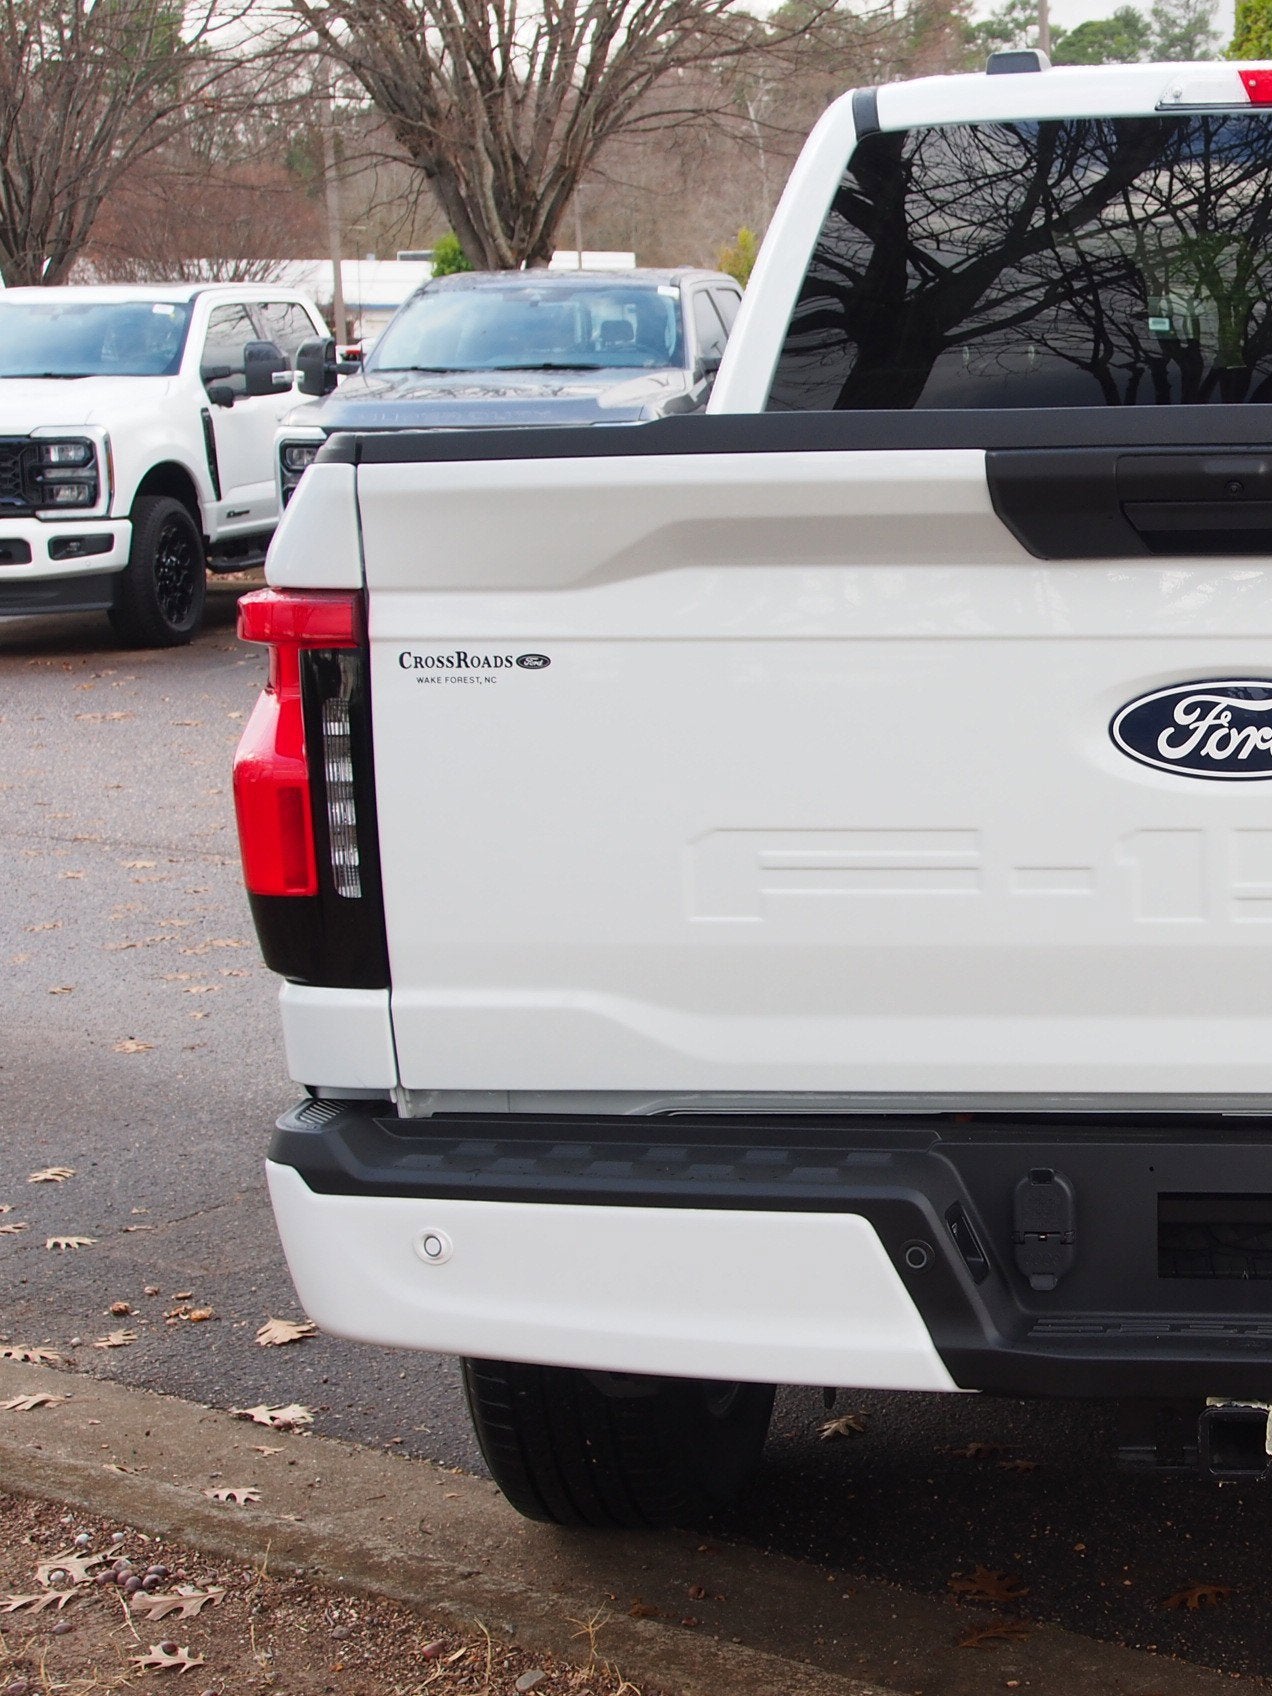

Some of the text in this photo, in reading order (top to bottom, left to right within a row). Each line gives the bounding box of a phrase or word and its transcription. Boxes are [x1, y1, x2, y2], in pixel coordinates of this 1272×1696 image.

[416, 676, 497, 685] WAKE FOREST, NC
